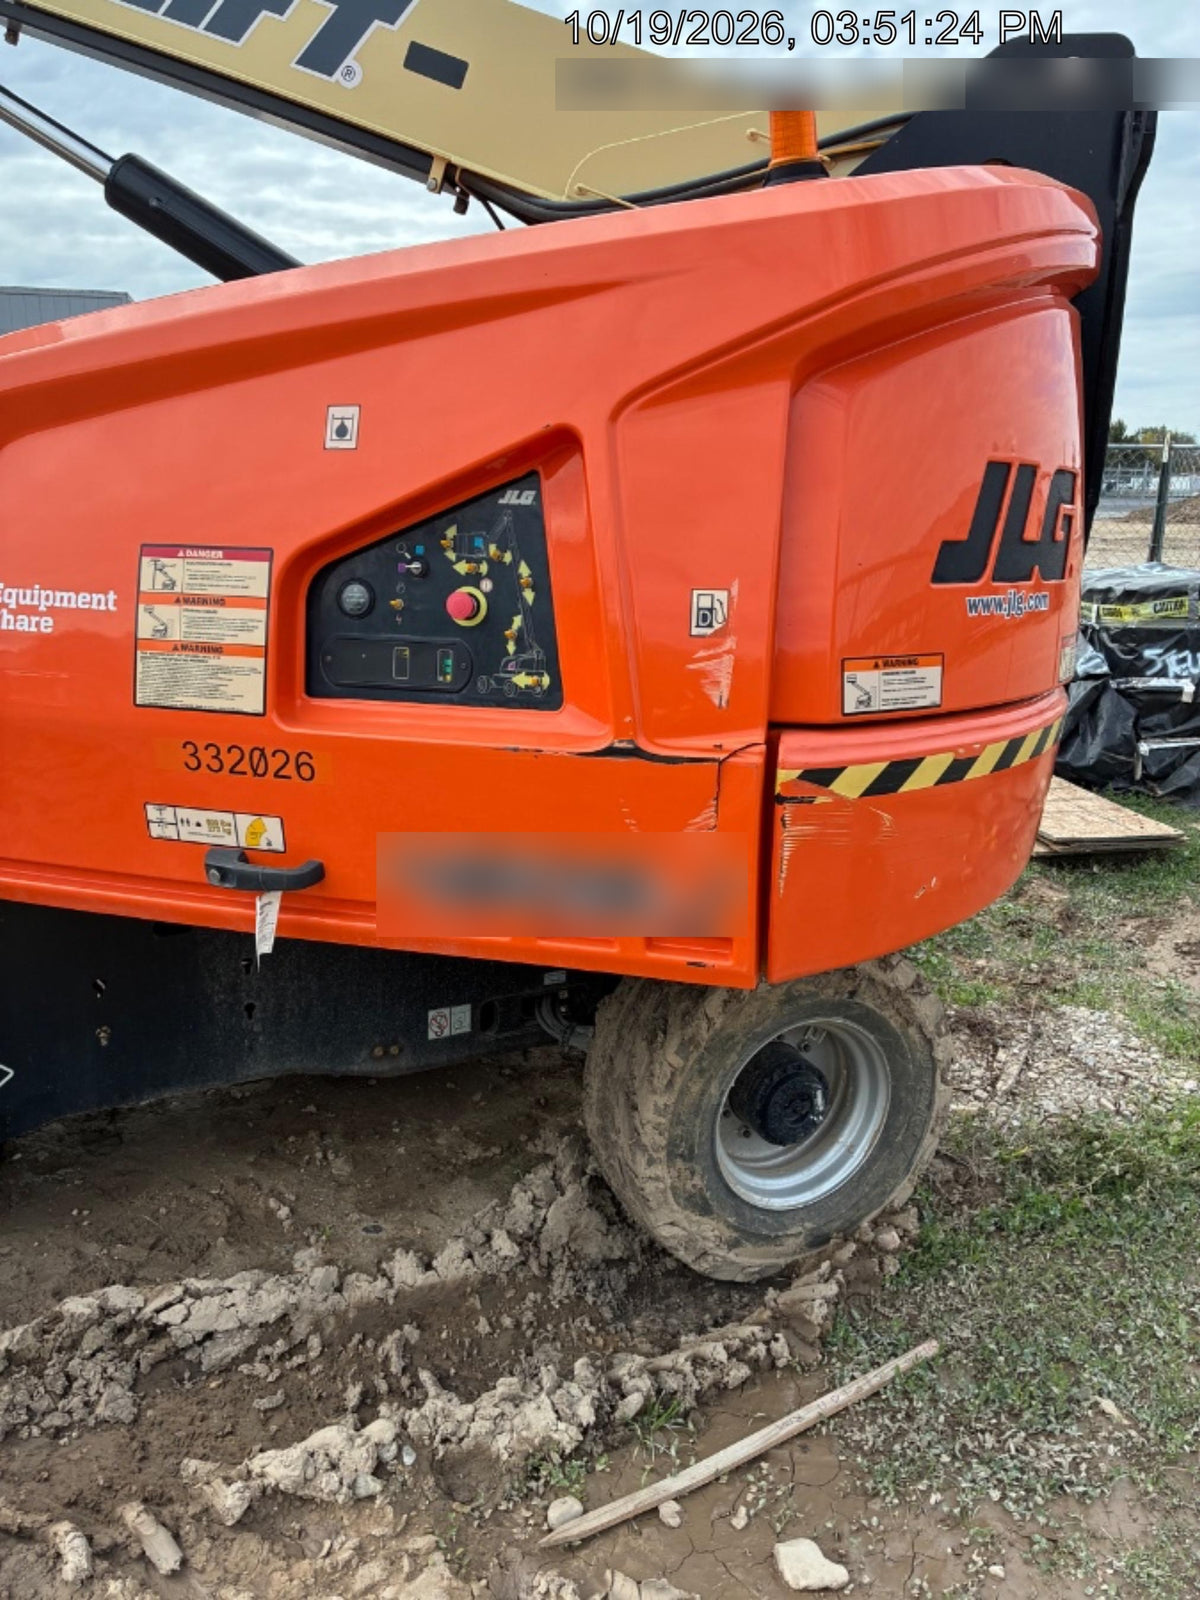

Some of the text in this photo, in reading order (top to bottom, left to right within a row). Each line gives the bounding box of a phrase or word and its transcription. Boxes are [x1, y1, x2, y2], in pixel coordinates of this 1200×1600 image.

[498, 490, 537, 505] JLG
[930, 460, 1077, 584] JLG
[186, 549, 223, 559] DANGER
[182, 596, 226, 606] WARNING
[0, 608, 54, 634] hare
[181, 643, 224, 654] WARNING
[182, 741, 316, 782] 332026
